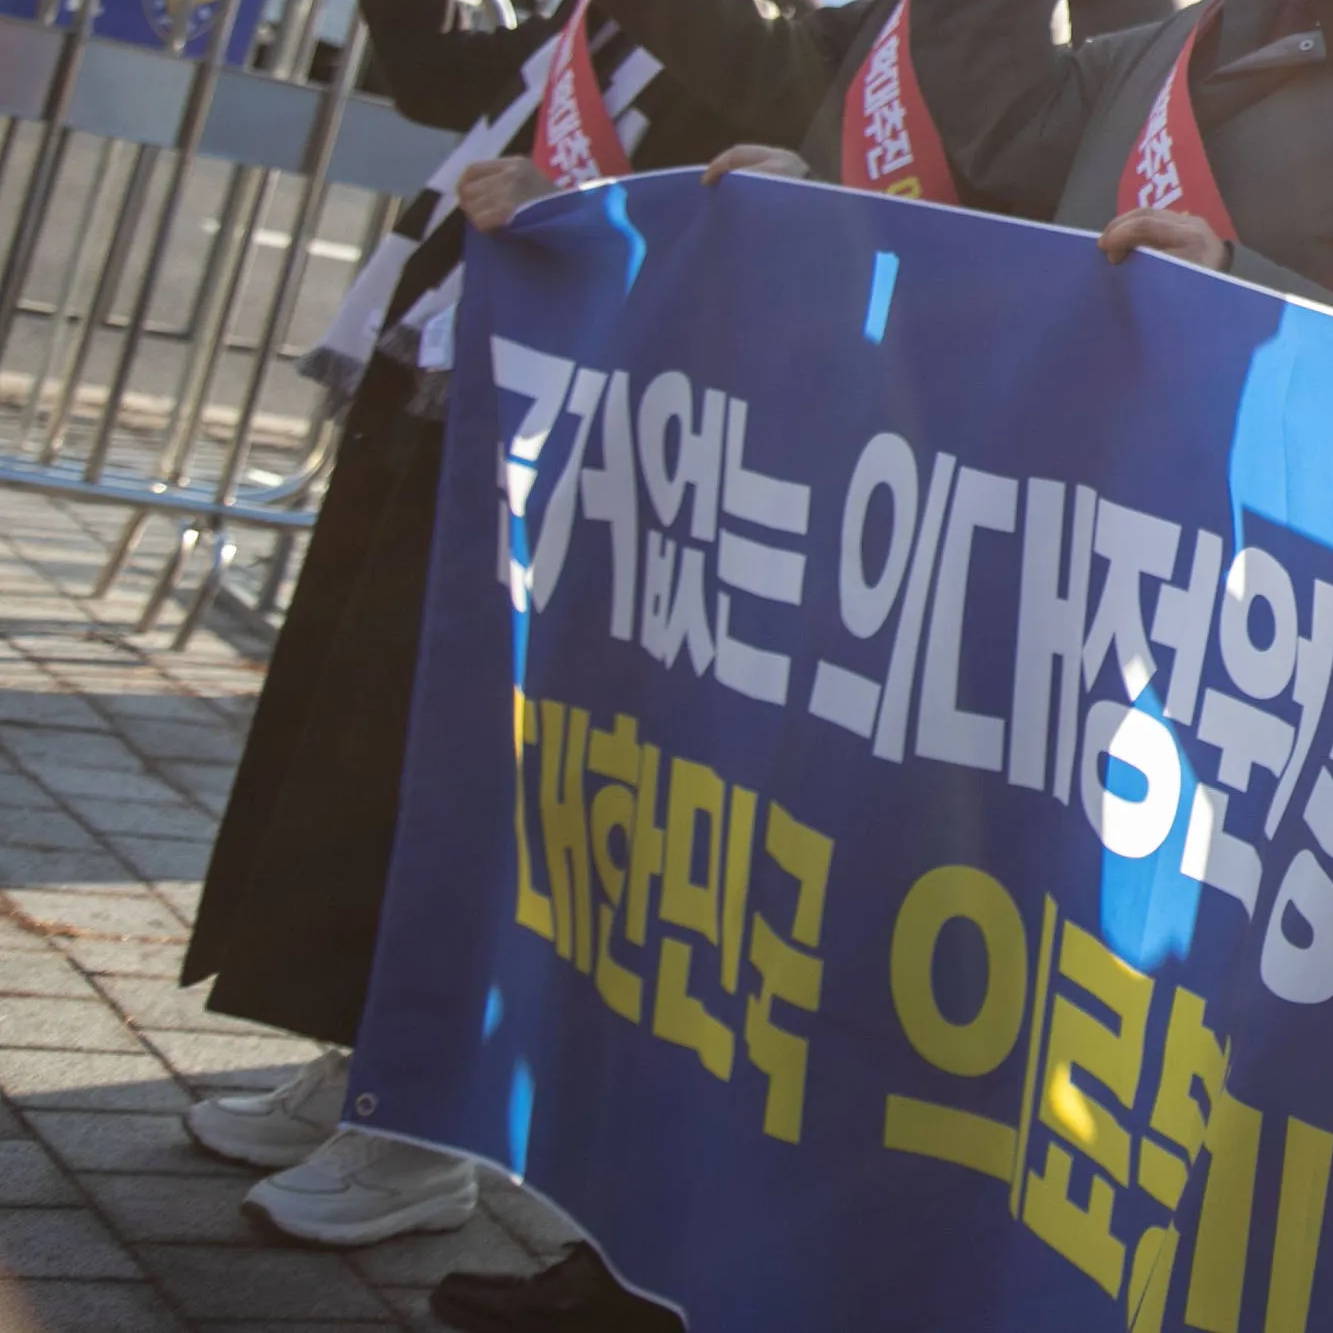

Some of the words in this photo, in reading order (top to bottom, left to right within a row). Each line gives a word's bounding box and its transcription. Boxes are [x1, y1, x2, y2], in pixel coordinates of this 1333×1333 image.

[864, 34, 914, 181] 확대추진
[490, 334, 812, 705] 근거없는
[514, 683, 834, 1145] 대한민국
